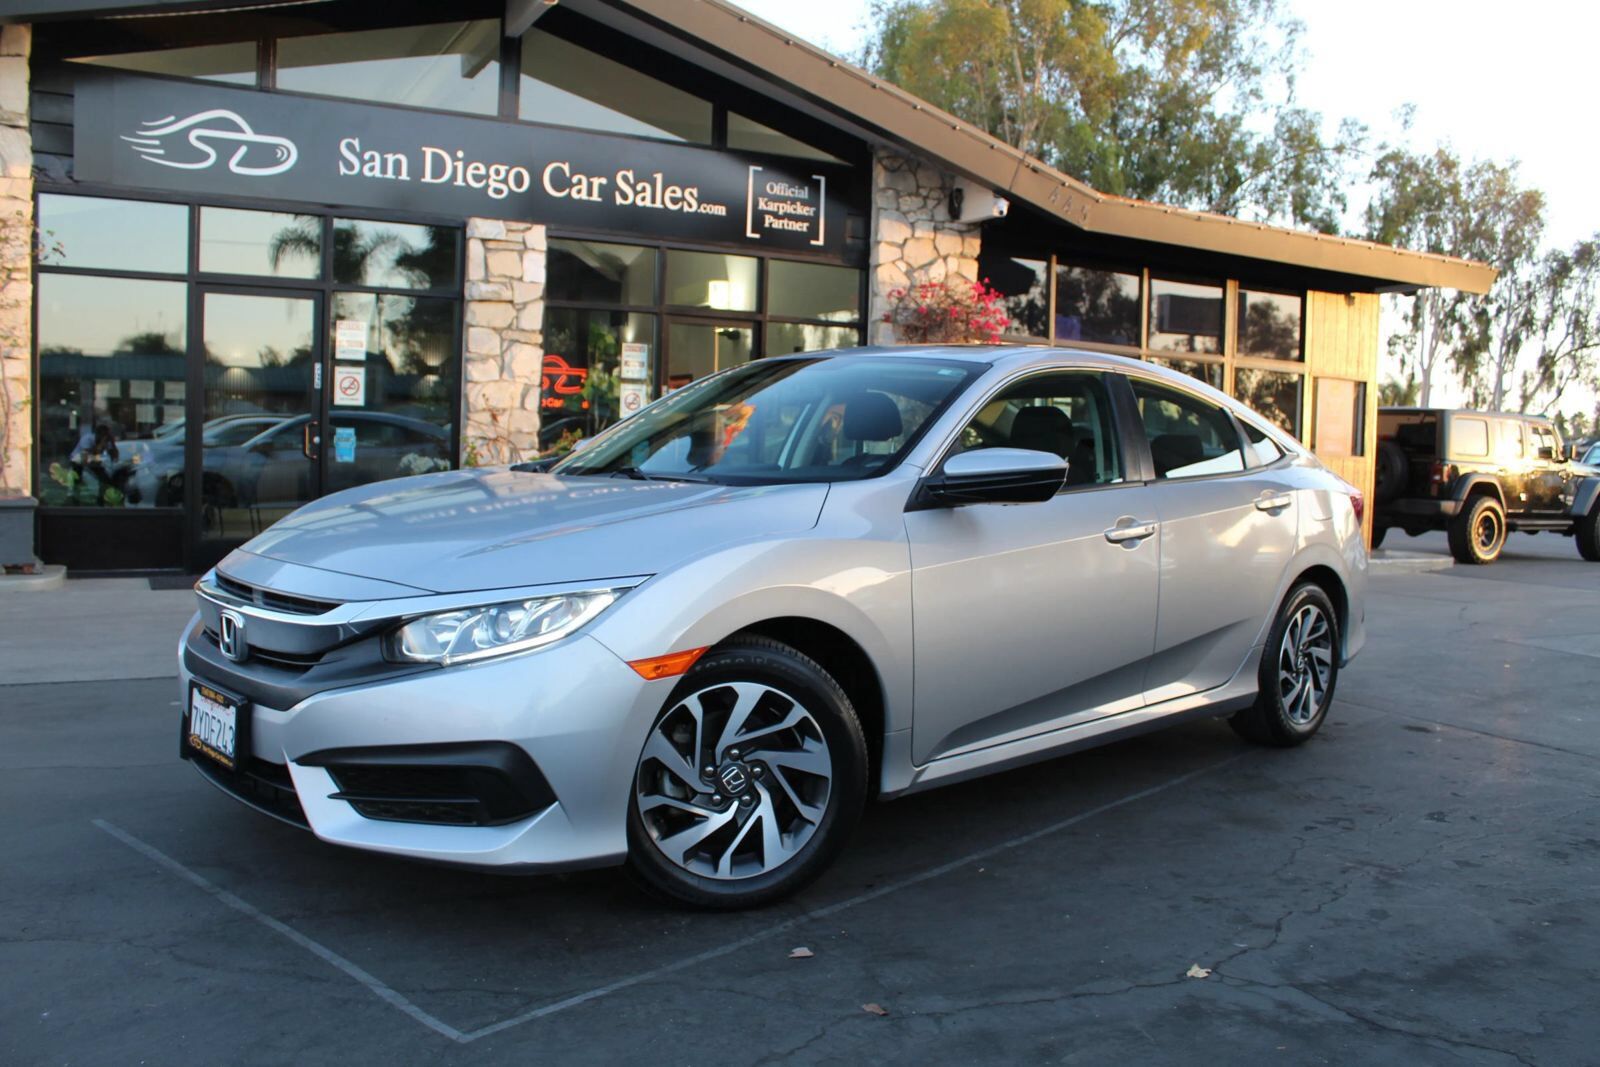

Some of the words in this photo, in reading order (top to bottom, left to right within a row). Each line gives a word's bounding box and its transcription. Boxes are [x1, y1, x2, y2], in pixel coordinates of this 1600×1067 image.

[339, 137, 411, 181] San
[421, 146, 529, 200] Diego
[543, 161, 608, 202] Car
[615, 169, 727, 216] Sales.com
[766, 181, 809, 199] Official
[758, 197, 816, 217] Karpicker
[764, 214, 809, 232] Partner
[193, 704, 235, 757] 7YDF243
